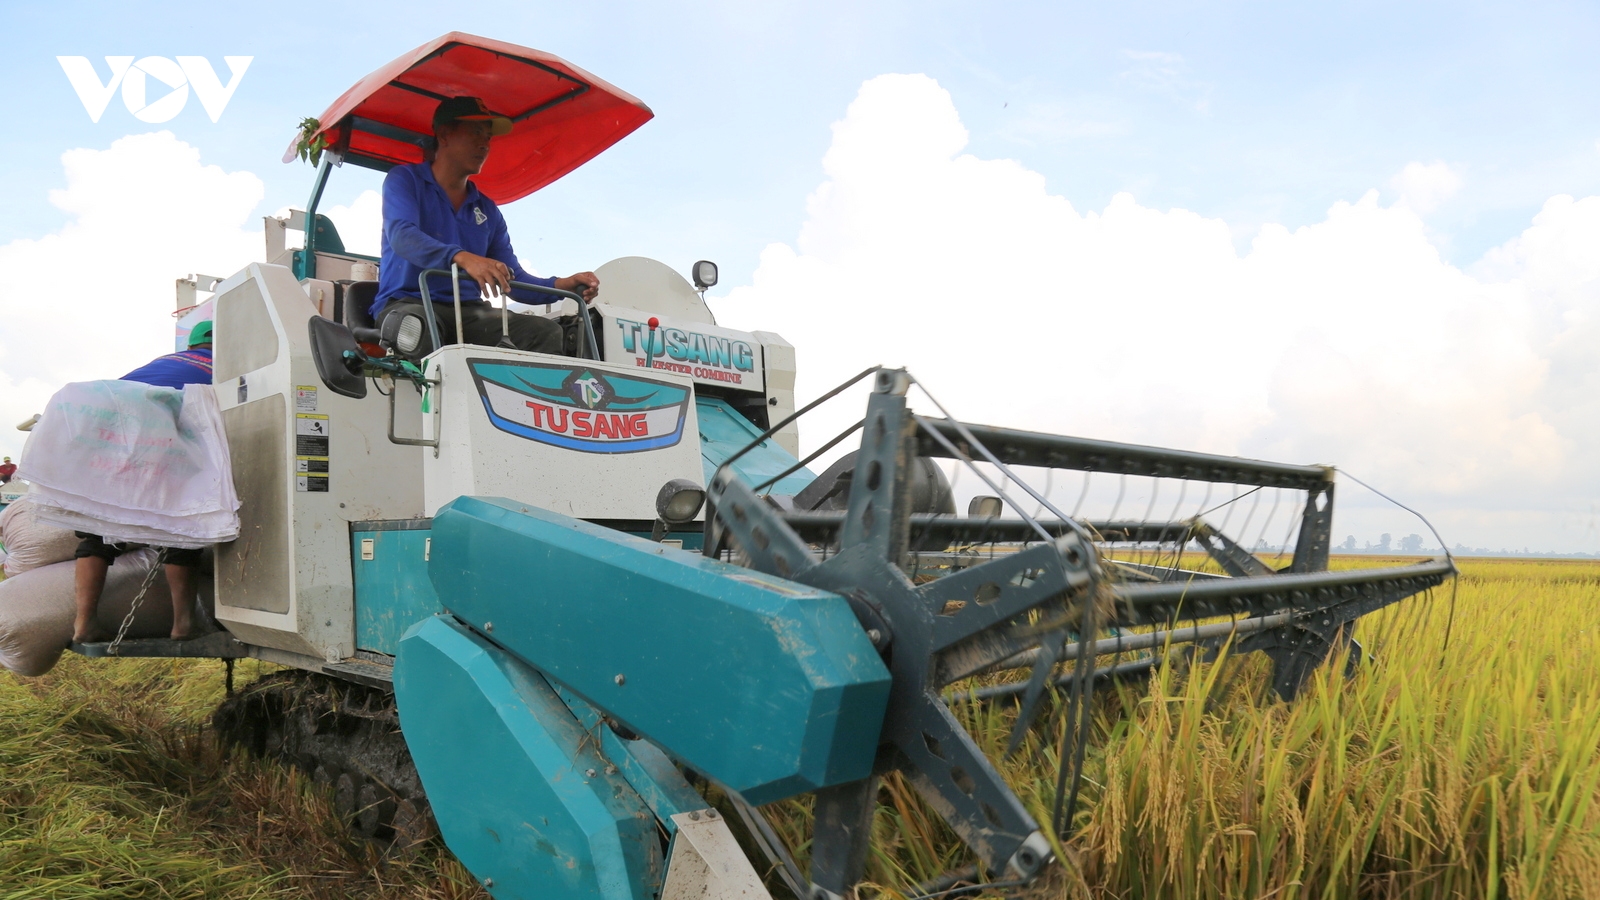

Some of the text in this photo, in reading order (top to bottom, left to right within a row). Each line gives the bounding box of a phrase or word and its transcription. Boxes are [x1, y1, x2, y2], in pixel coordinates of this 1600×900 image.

[635, 357, 742, 385] HVESTER COMBINE
[571, 411, 649, 439] SANG
